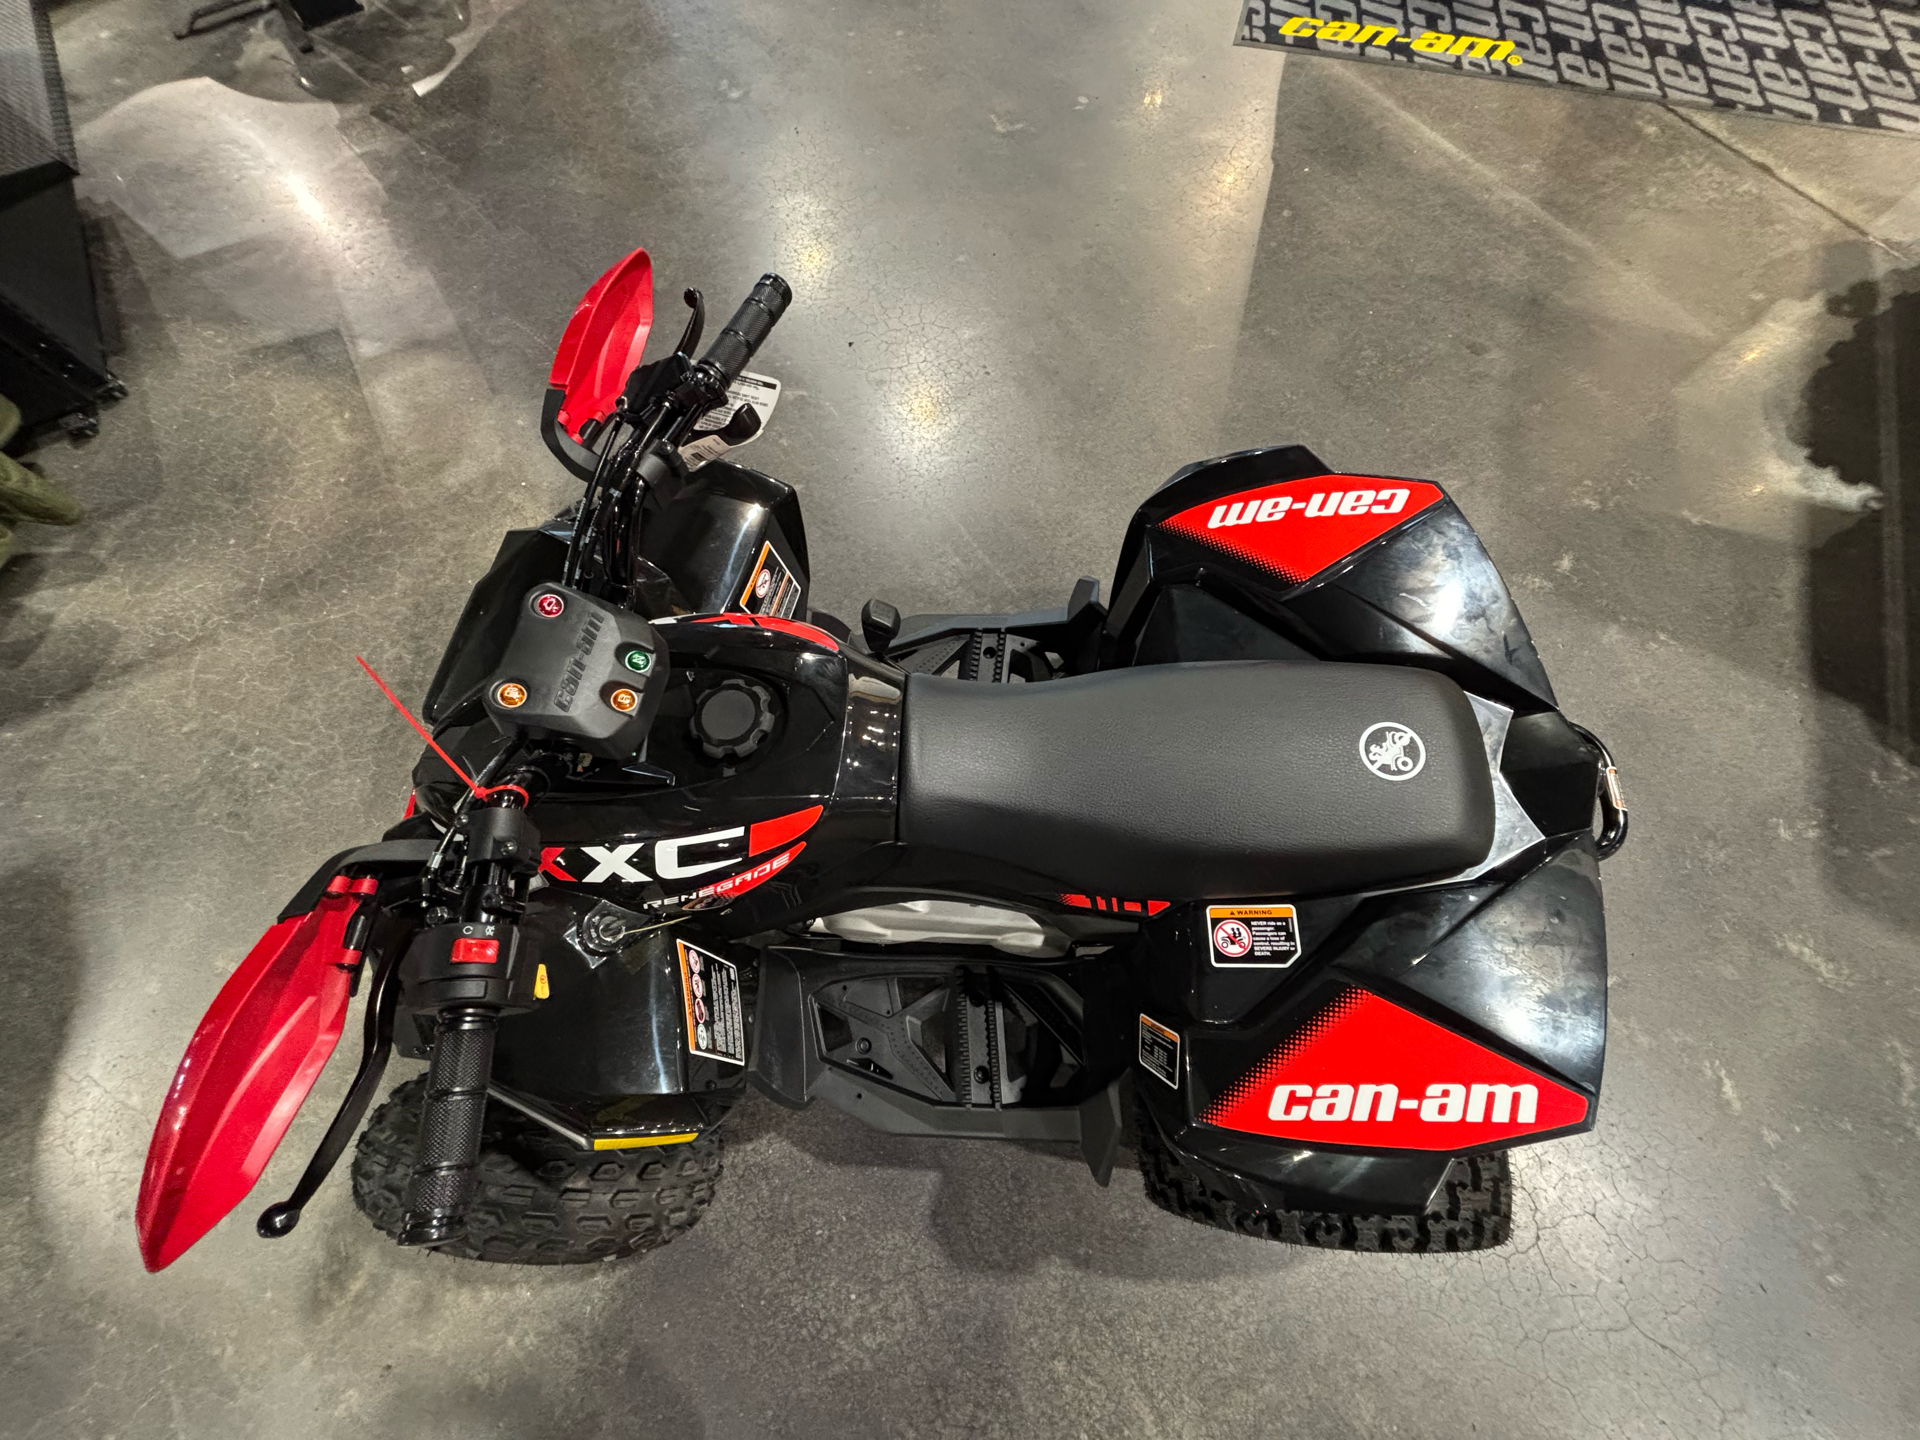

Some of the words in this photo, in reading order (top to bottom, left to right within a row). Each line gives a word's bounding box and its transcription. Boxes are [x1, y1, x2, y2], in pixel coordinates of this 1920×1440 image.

[1279, 16, 1515, 60] can-am
[1207, 487, 1411, 530] can-am
[553, 611, 605, 713] can-am
[643, 852, 790, 910] RENEGADE
[1268, 1083, 1539, 1124] can-am
